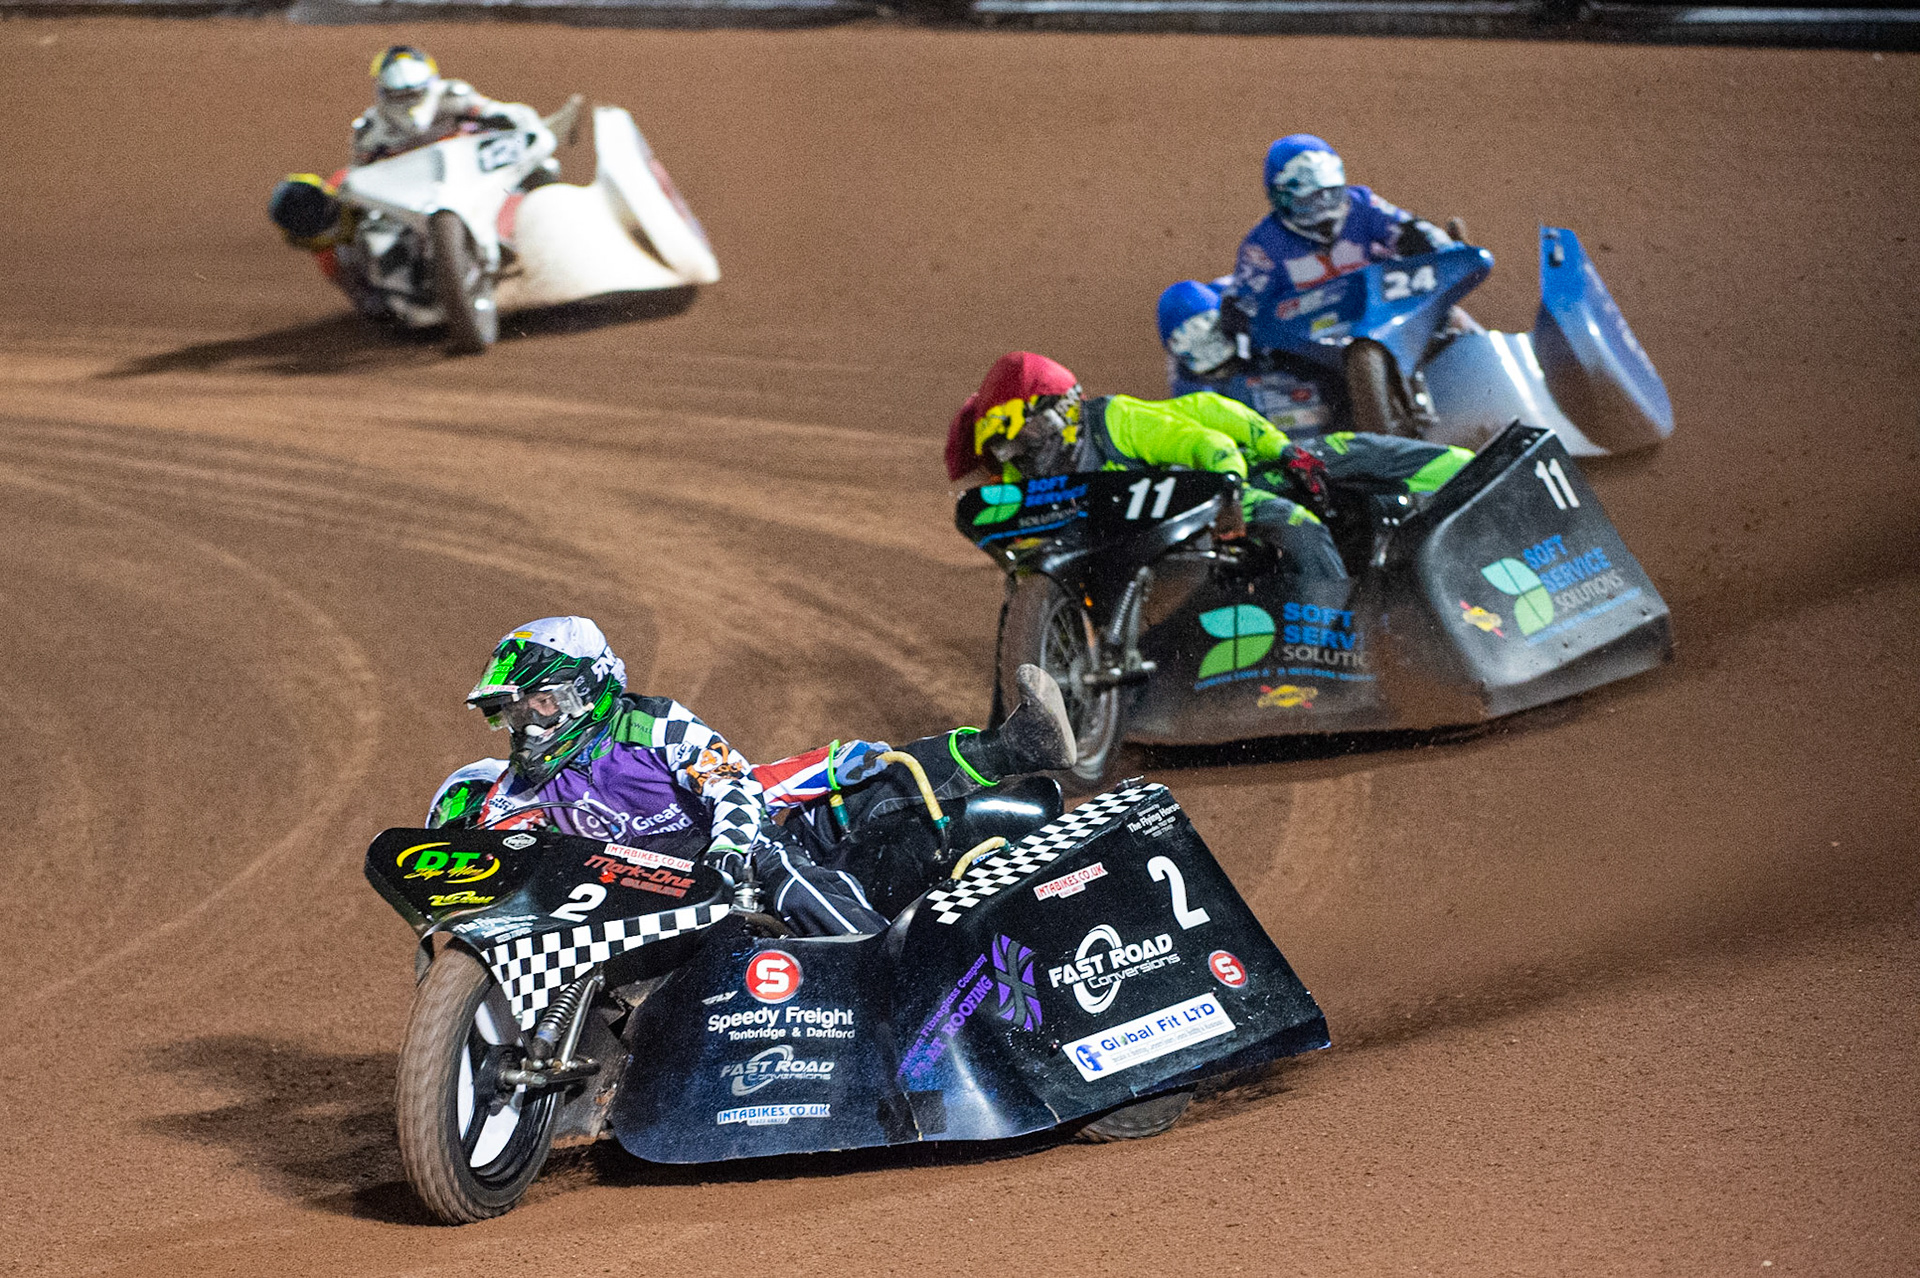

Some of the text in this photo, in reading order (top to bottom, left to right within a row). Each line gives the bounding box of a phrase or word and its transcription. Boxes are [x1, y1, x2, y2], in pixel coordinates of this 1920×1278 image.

[1383, 265, 1437, 300] 24
[1126, 477, 1176, 520] 11
[1535, 458, 1580, 510] 11
[1523, 534, 1568, 570] SOFT
[1540, 547, 1611, 593] SERVICE
[1555, 569, 1624, 612] SOLUTIONS
[1283, 602, 1354, 628] SOFT
[632, 803, 682, 830] Great
[1127, 822, 1142, 832] The
[1140, 812, 1162, 827] Flying
[1158, 803, 1181, 817] Horse
[413, 850, 480, 870] DT
[607, 844, 691, 869] INTABIKES.CO.UK
[1035, 864, 1105, 898] INTABIKES.CO.UK
[1146, 855, 1211, 930] 2
[549, 883, 607, 923] 2
[1048, 933, 1173, 988] FAST ROAD
[1088, 953, 1180, 989] Conversions
[920, 987, 961, 1037] Fibreglass
[957, 953, 987, 988] Company
[941, 975, 994, 1038] ROOFING
[708, 1006, 854, 1033] Speedy Freight
[728, 1027, 855, 1041] Tonbridge & Dartford
[1156, 1015, 1181, 1031] Fit
[1183, 1003, 1215, 1022] LTD
[720, 1060, 835, 1078] FAST ROAD
[748, 1073, 831, 1081] Conversions
[719, 1106, 827, 1122] INTABIKES.CO.UK
